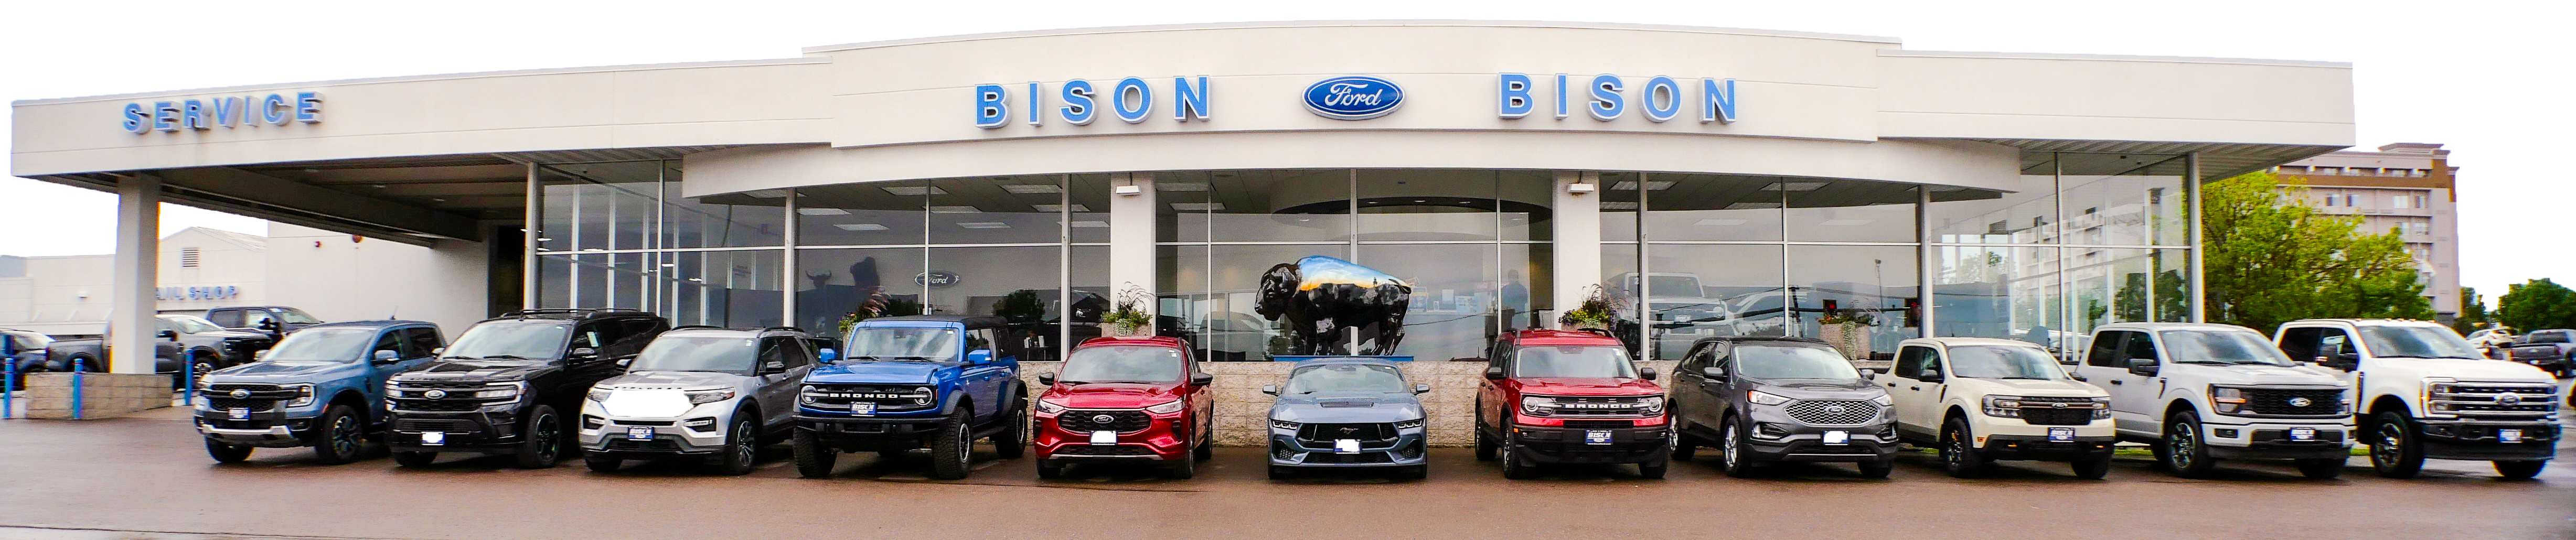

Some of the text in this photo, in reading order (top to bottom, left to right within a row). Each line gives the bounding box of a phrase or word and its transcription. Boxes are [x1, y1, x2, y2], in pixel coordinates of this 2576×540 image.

[123, 92, 324, 134] SERVICE
[975, 75, 1210, 128] BISON
[1324, 83, 1383, 106] Ford
[1498, 72, 1736, 123] BISON
[188, 286, 239, 300] SHOP
